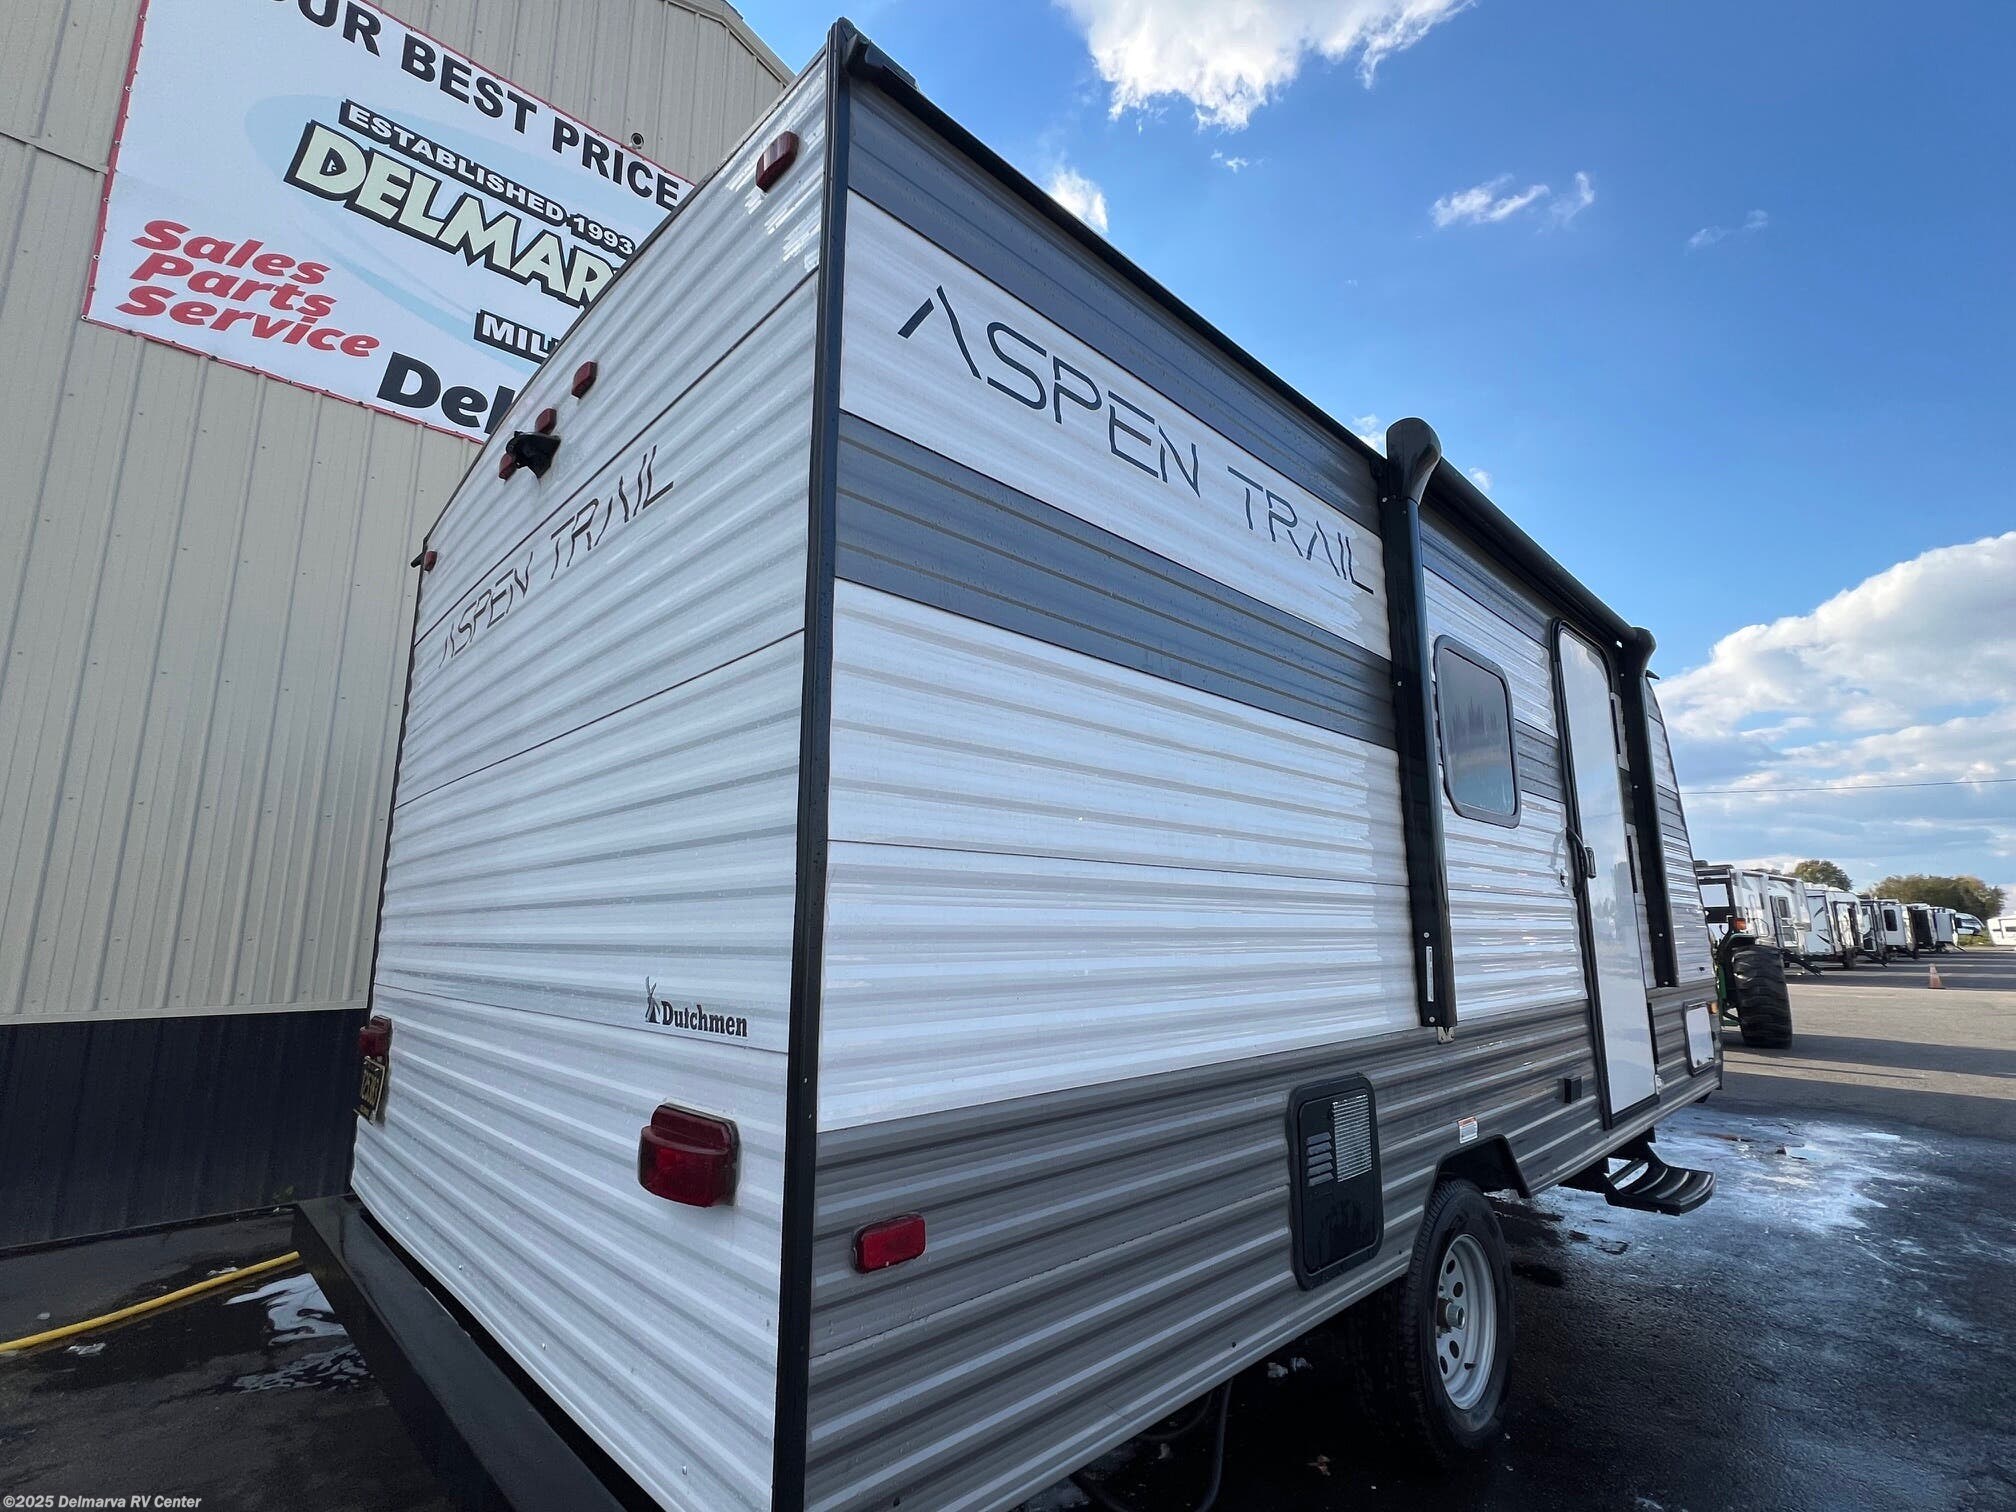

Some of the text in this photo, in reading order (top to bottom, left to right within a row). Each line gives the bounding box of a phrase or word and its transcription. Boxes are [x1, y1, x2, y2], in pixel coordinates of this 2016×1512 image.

[271, 0, 680, 212] UR BEST PRICE
[348, 103, 634, 255] ESTABLISHED 1993
[129, 252, 337, 317] Parts
[131, 220, 331, 284] Sales
[295, 124, 618, 302] DELMAR
[115, 285, 380, 357] Service
[897, 285, 1375, 595] ASPEN TRAIL
[438, 444, 674, 669] ASPEN TRAIL
[661, 1000, 748, 1037] Dutchmen
